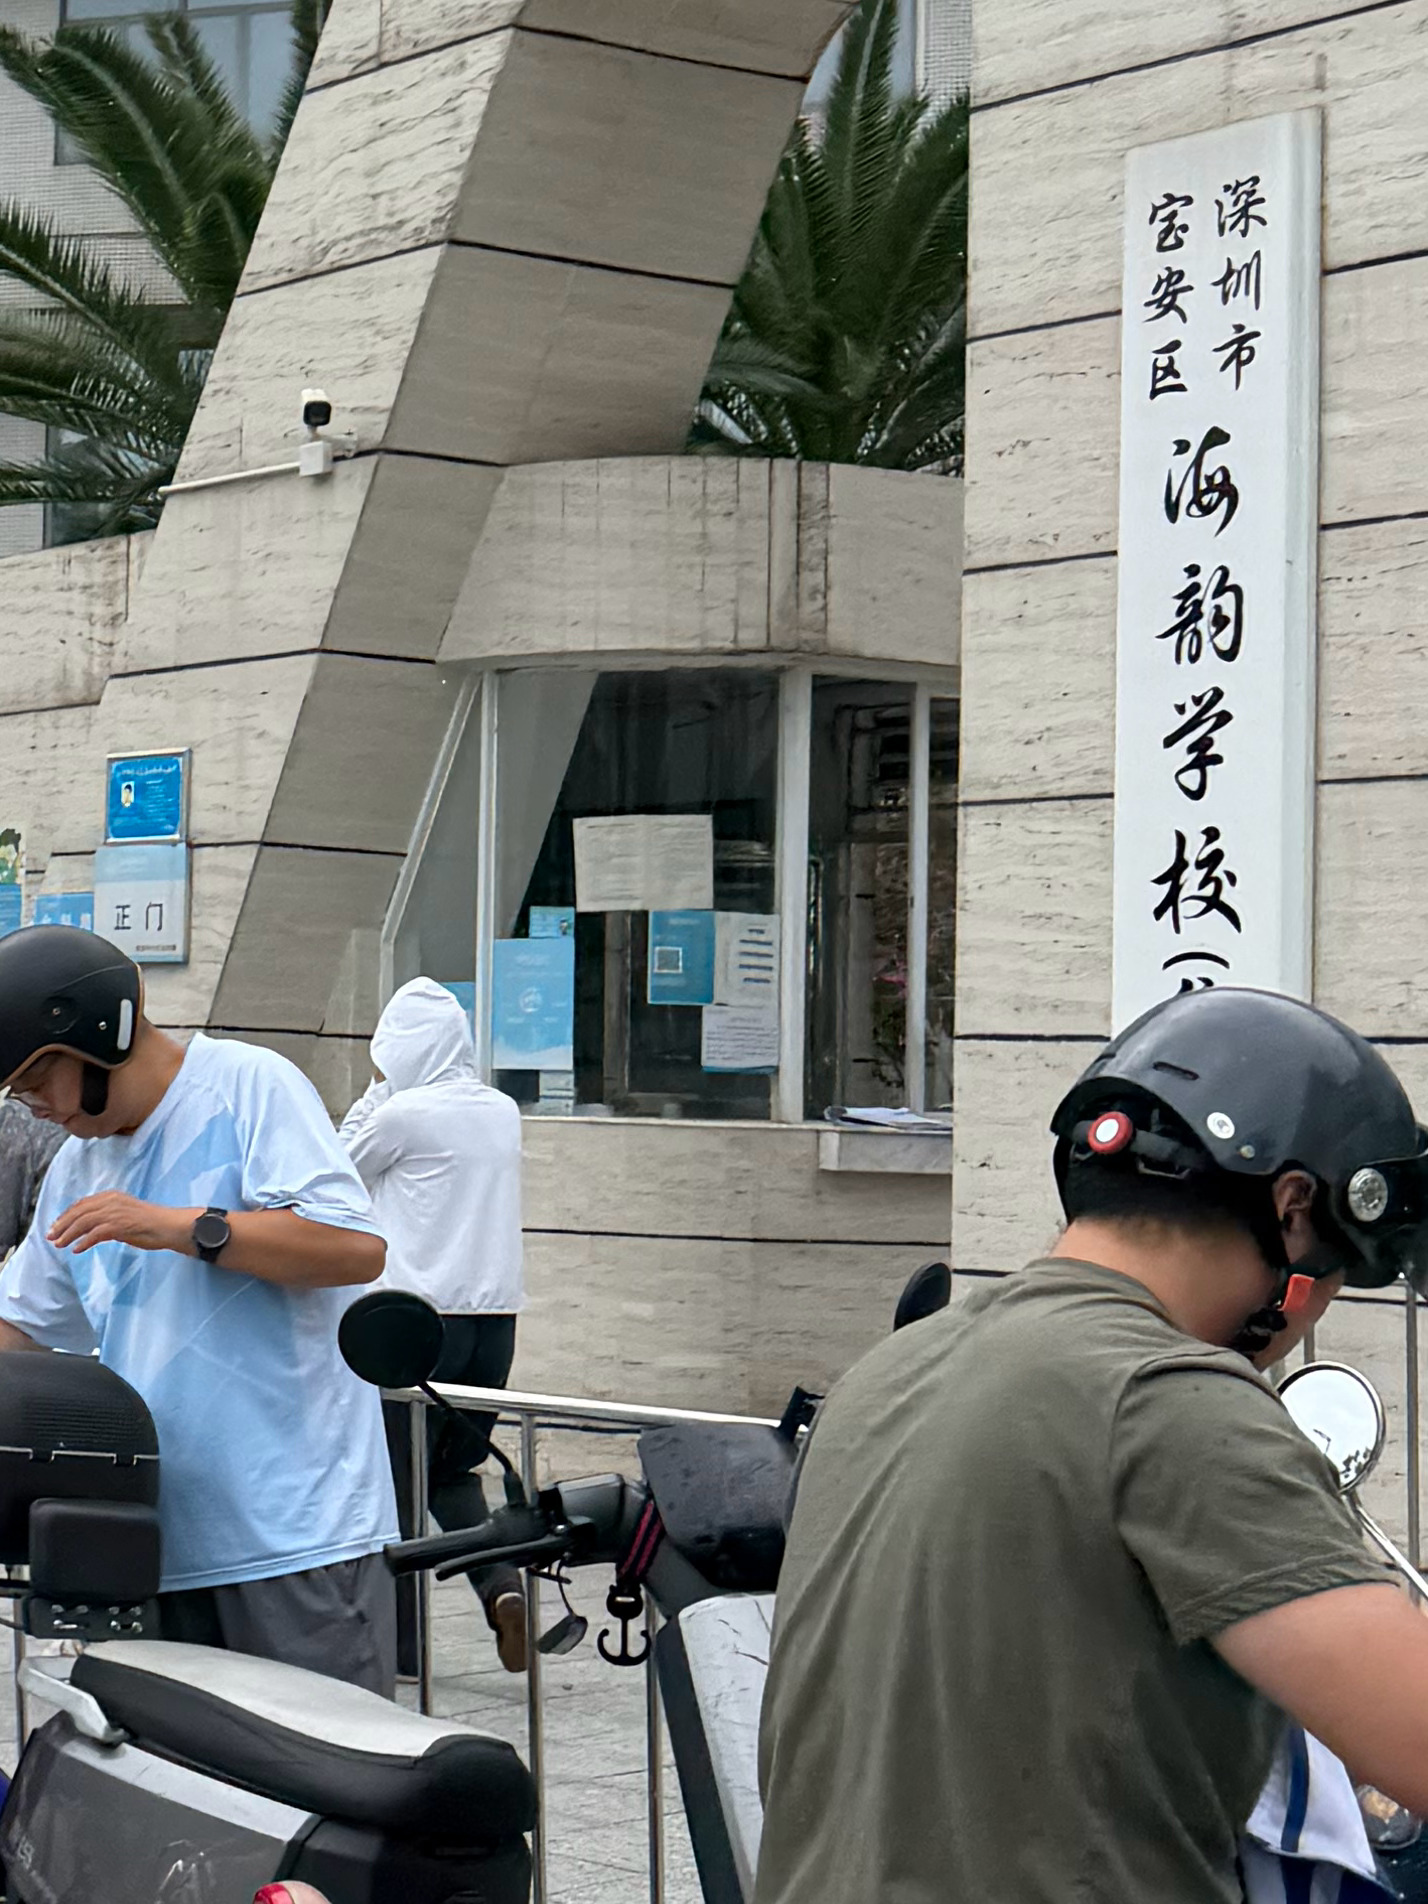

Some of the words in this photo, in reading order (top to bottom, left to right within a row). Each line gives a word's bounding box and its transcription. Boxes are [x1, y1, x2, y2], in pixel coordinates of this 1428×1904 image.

[1142, 190, 1194, 399] 宝安区
[1210, 181, 1269, 392] 深圳市
[113, 901, 164, 932] 正门
